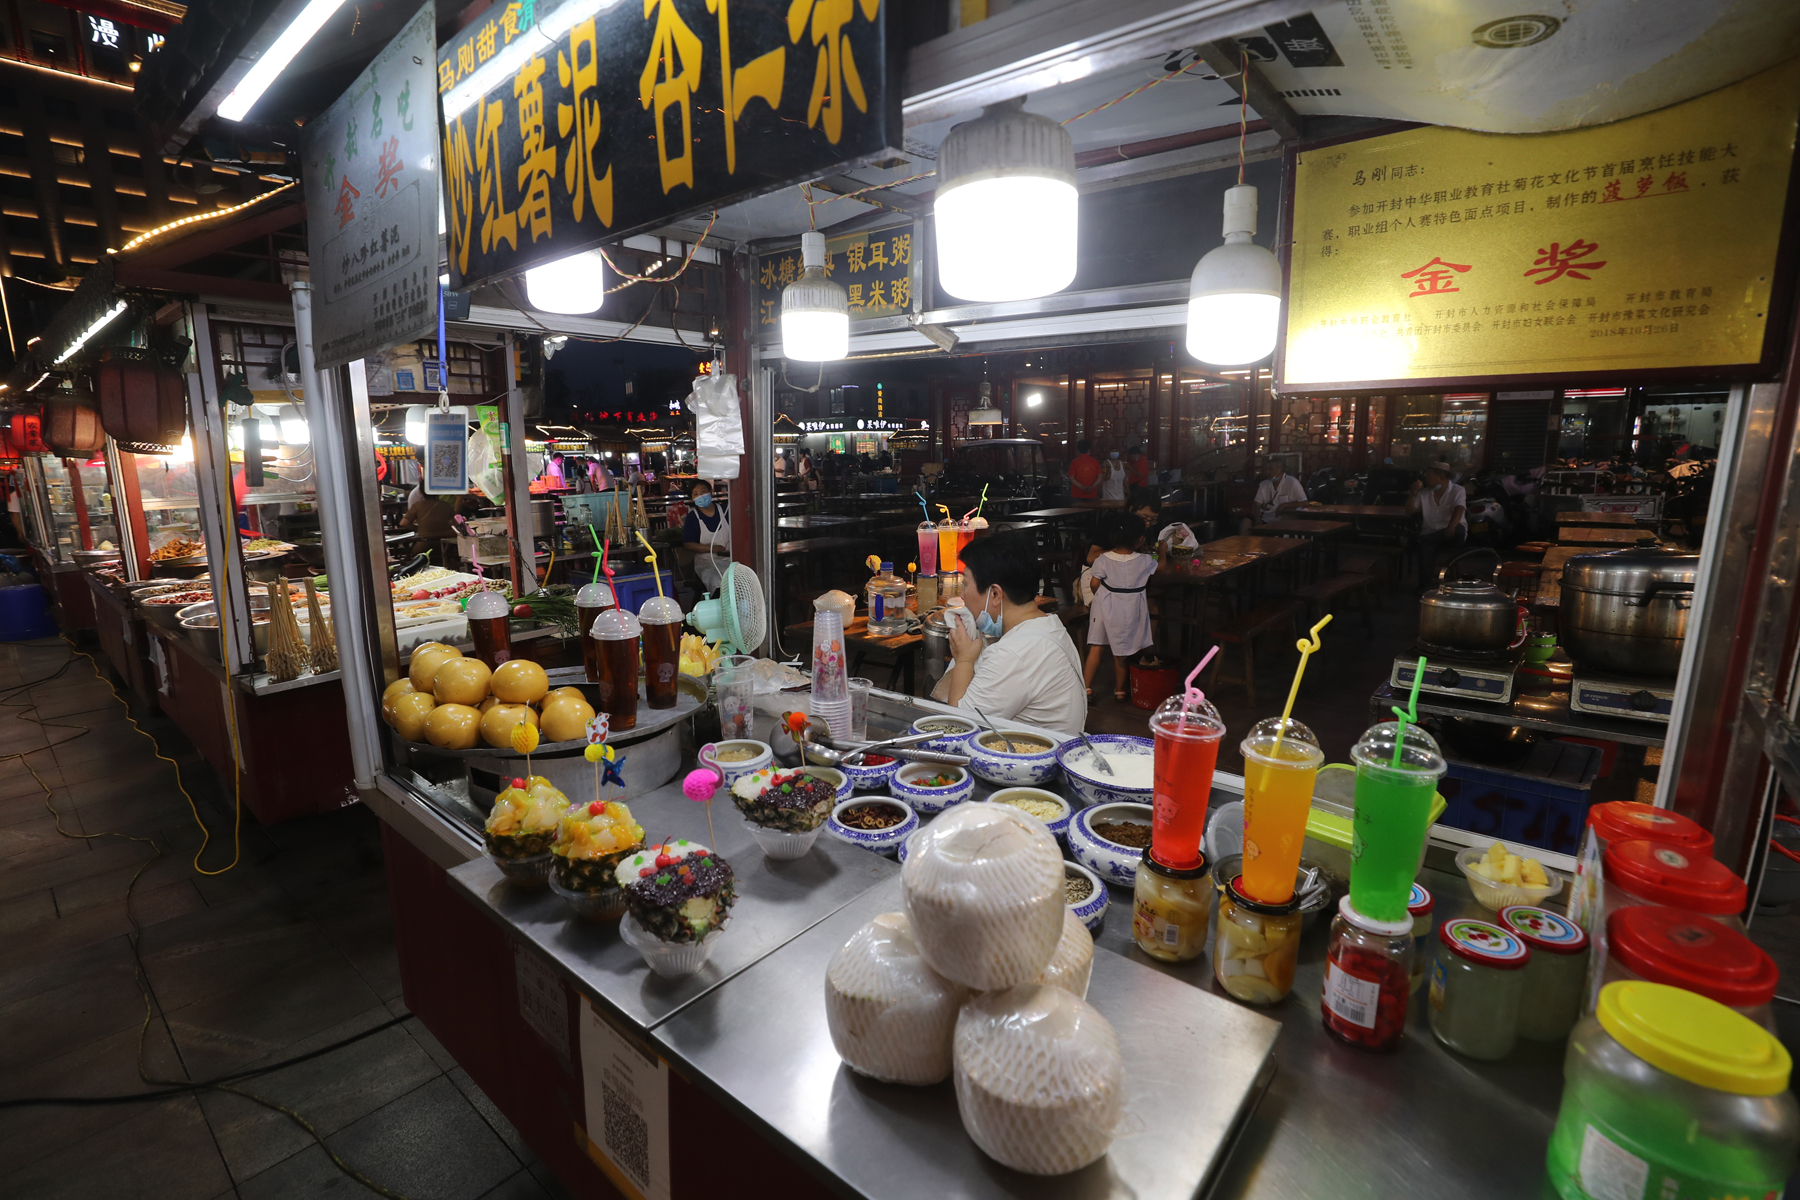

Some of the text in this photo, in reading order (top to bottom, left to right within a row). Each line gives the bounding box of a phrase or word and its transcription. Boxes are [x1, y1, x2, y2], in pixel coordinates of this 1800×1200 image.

[438, 2, 522, 94] 马刚甜食
[323, 79, 414, 193] 开封名吃
[334, 134, 404, 230] 金奖
[444, 15, 614, 276] 炒红薯泥
[846, 233, 912, 274] 银耳粥
[846, 276, 911, 314] 黑米粥
[1589, 322, 1679, 339] 2018年10月26日
